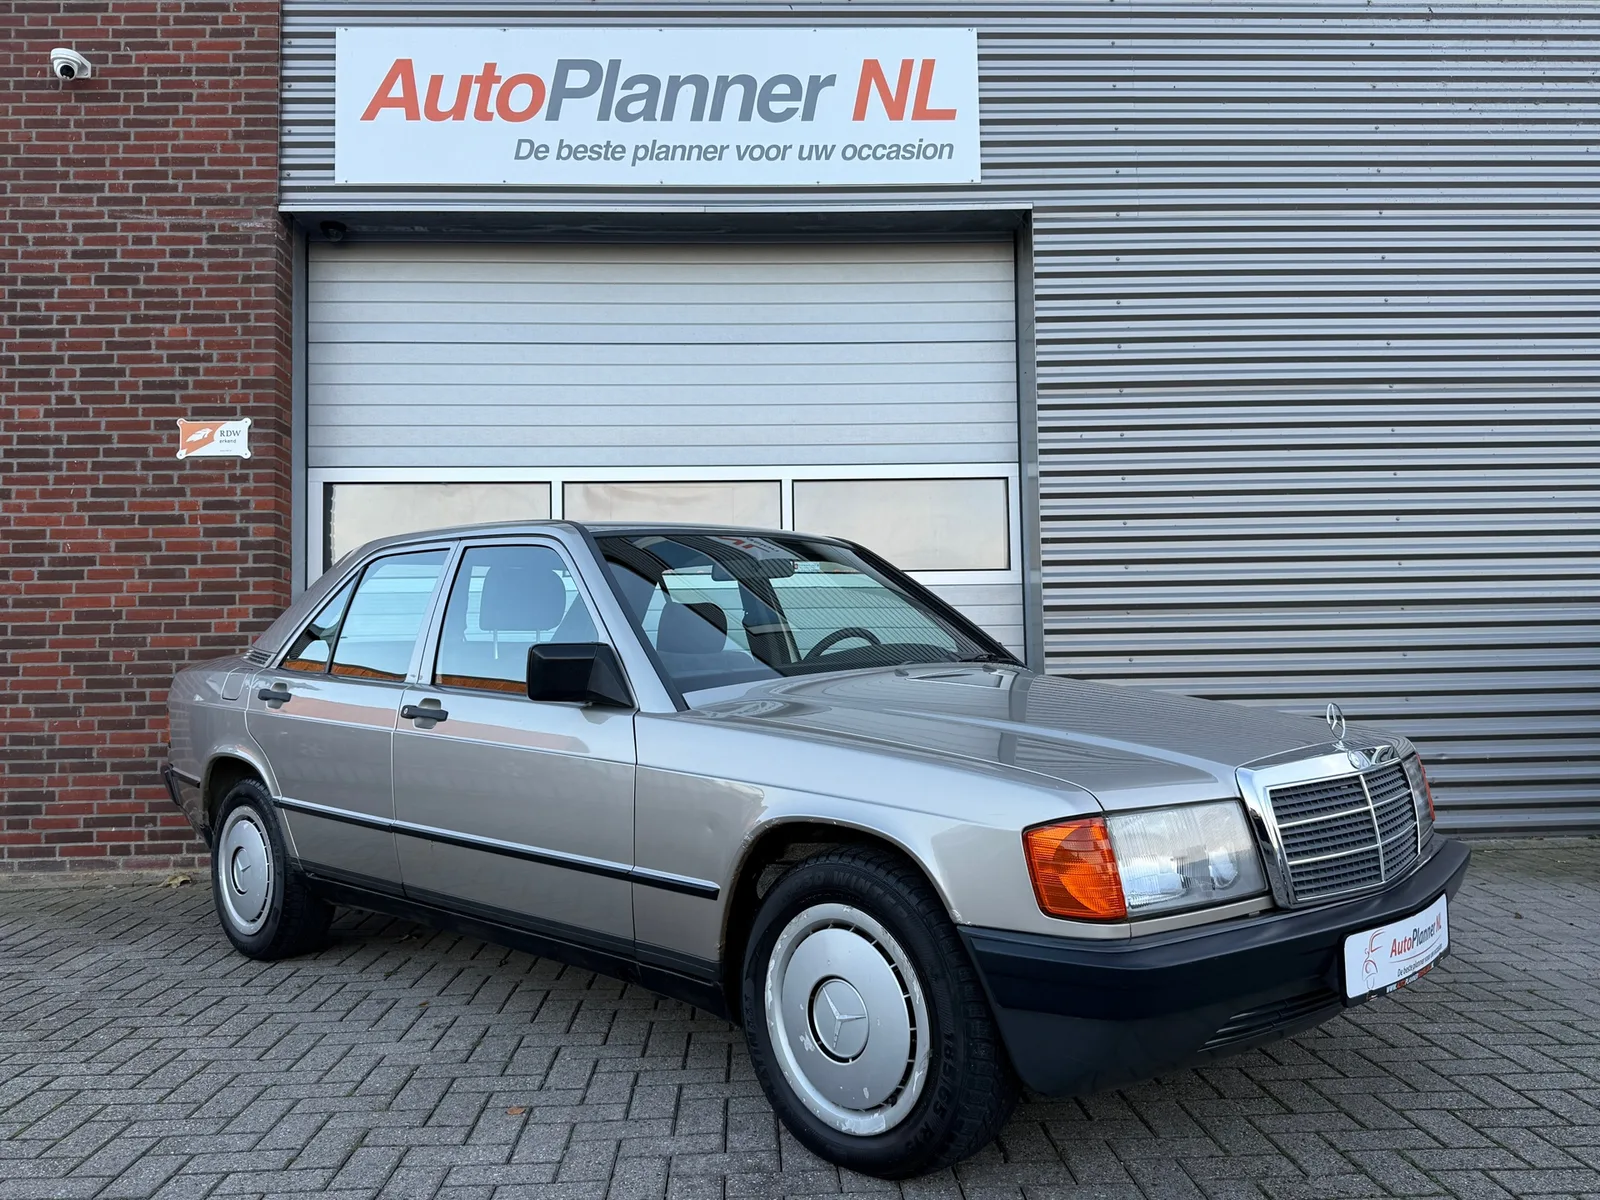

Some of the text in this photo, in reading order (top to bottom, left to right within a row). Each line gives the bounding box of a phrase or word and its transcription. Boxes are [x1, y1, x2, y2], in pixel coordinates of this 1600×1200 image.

[359, 58, 958, 123] AutoPlanner NL
[513, 138, 955, 167] De beste planner voor uw occasion
[1389, 921, 1436, 958] AutoPlanner
